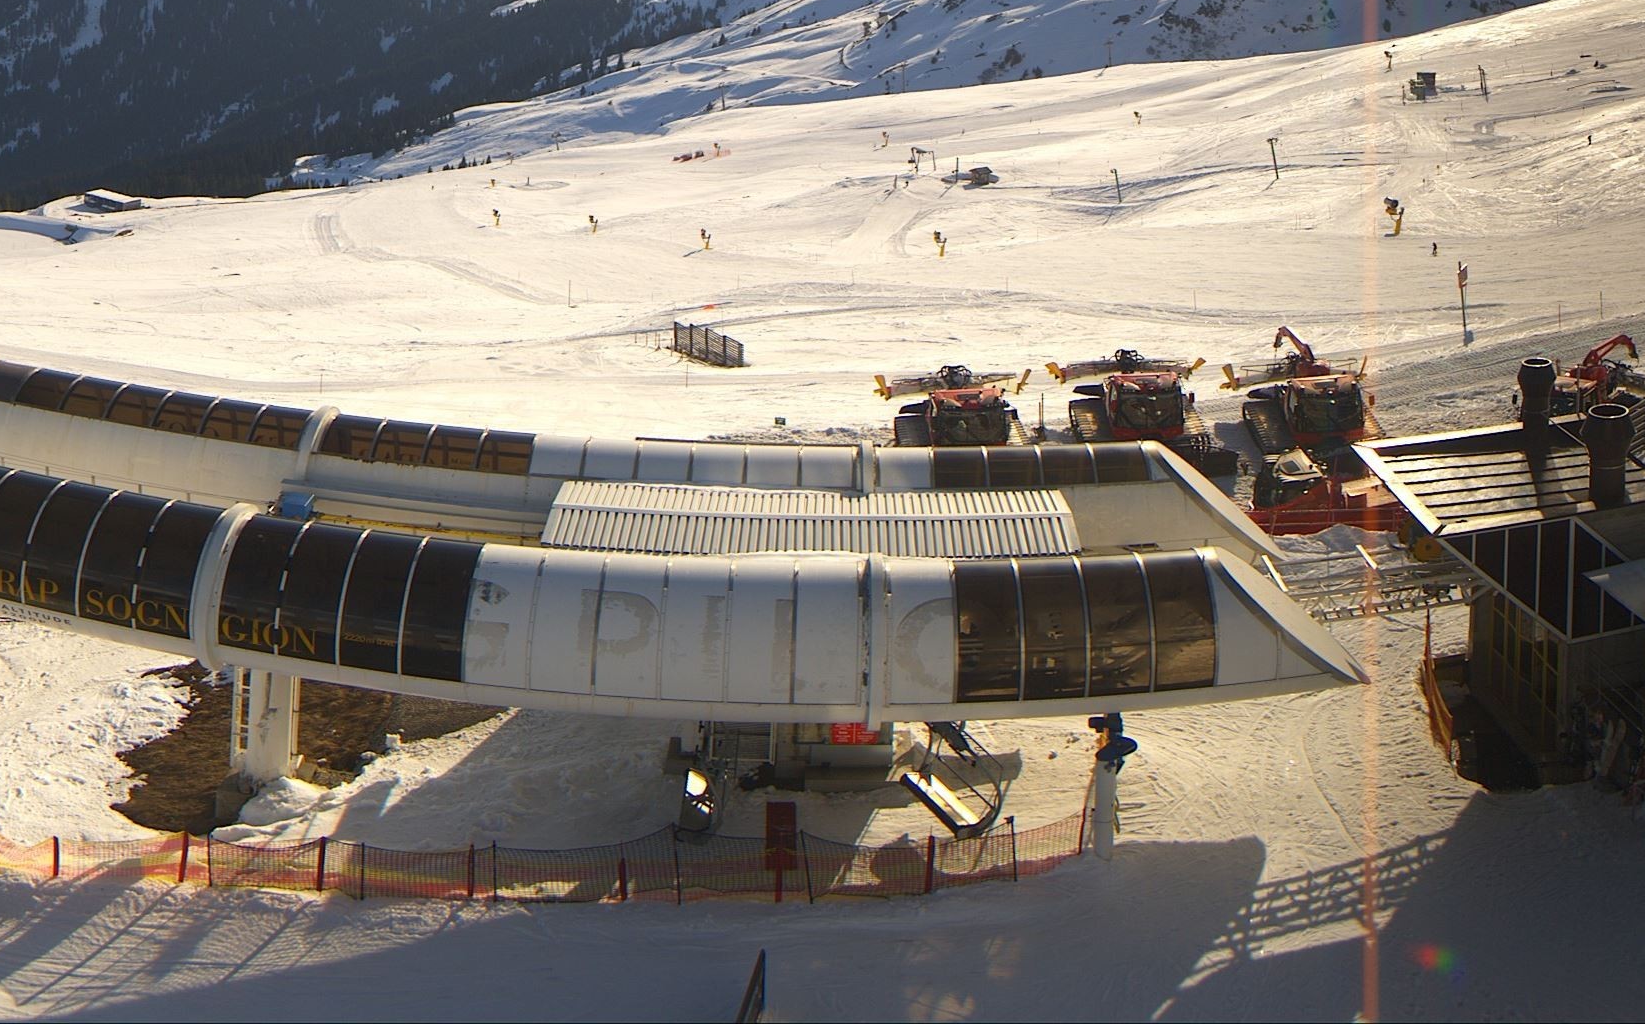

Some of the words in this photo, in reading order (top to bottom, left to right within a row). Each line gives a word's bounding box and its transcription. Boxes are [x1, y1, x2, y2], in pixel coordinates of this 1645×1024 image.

[2, 604, 73, 626] ALTITUDE
[85, 589, 190, 633] SOGN
[222, 614, 317, 655] GION
